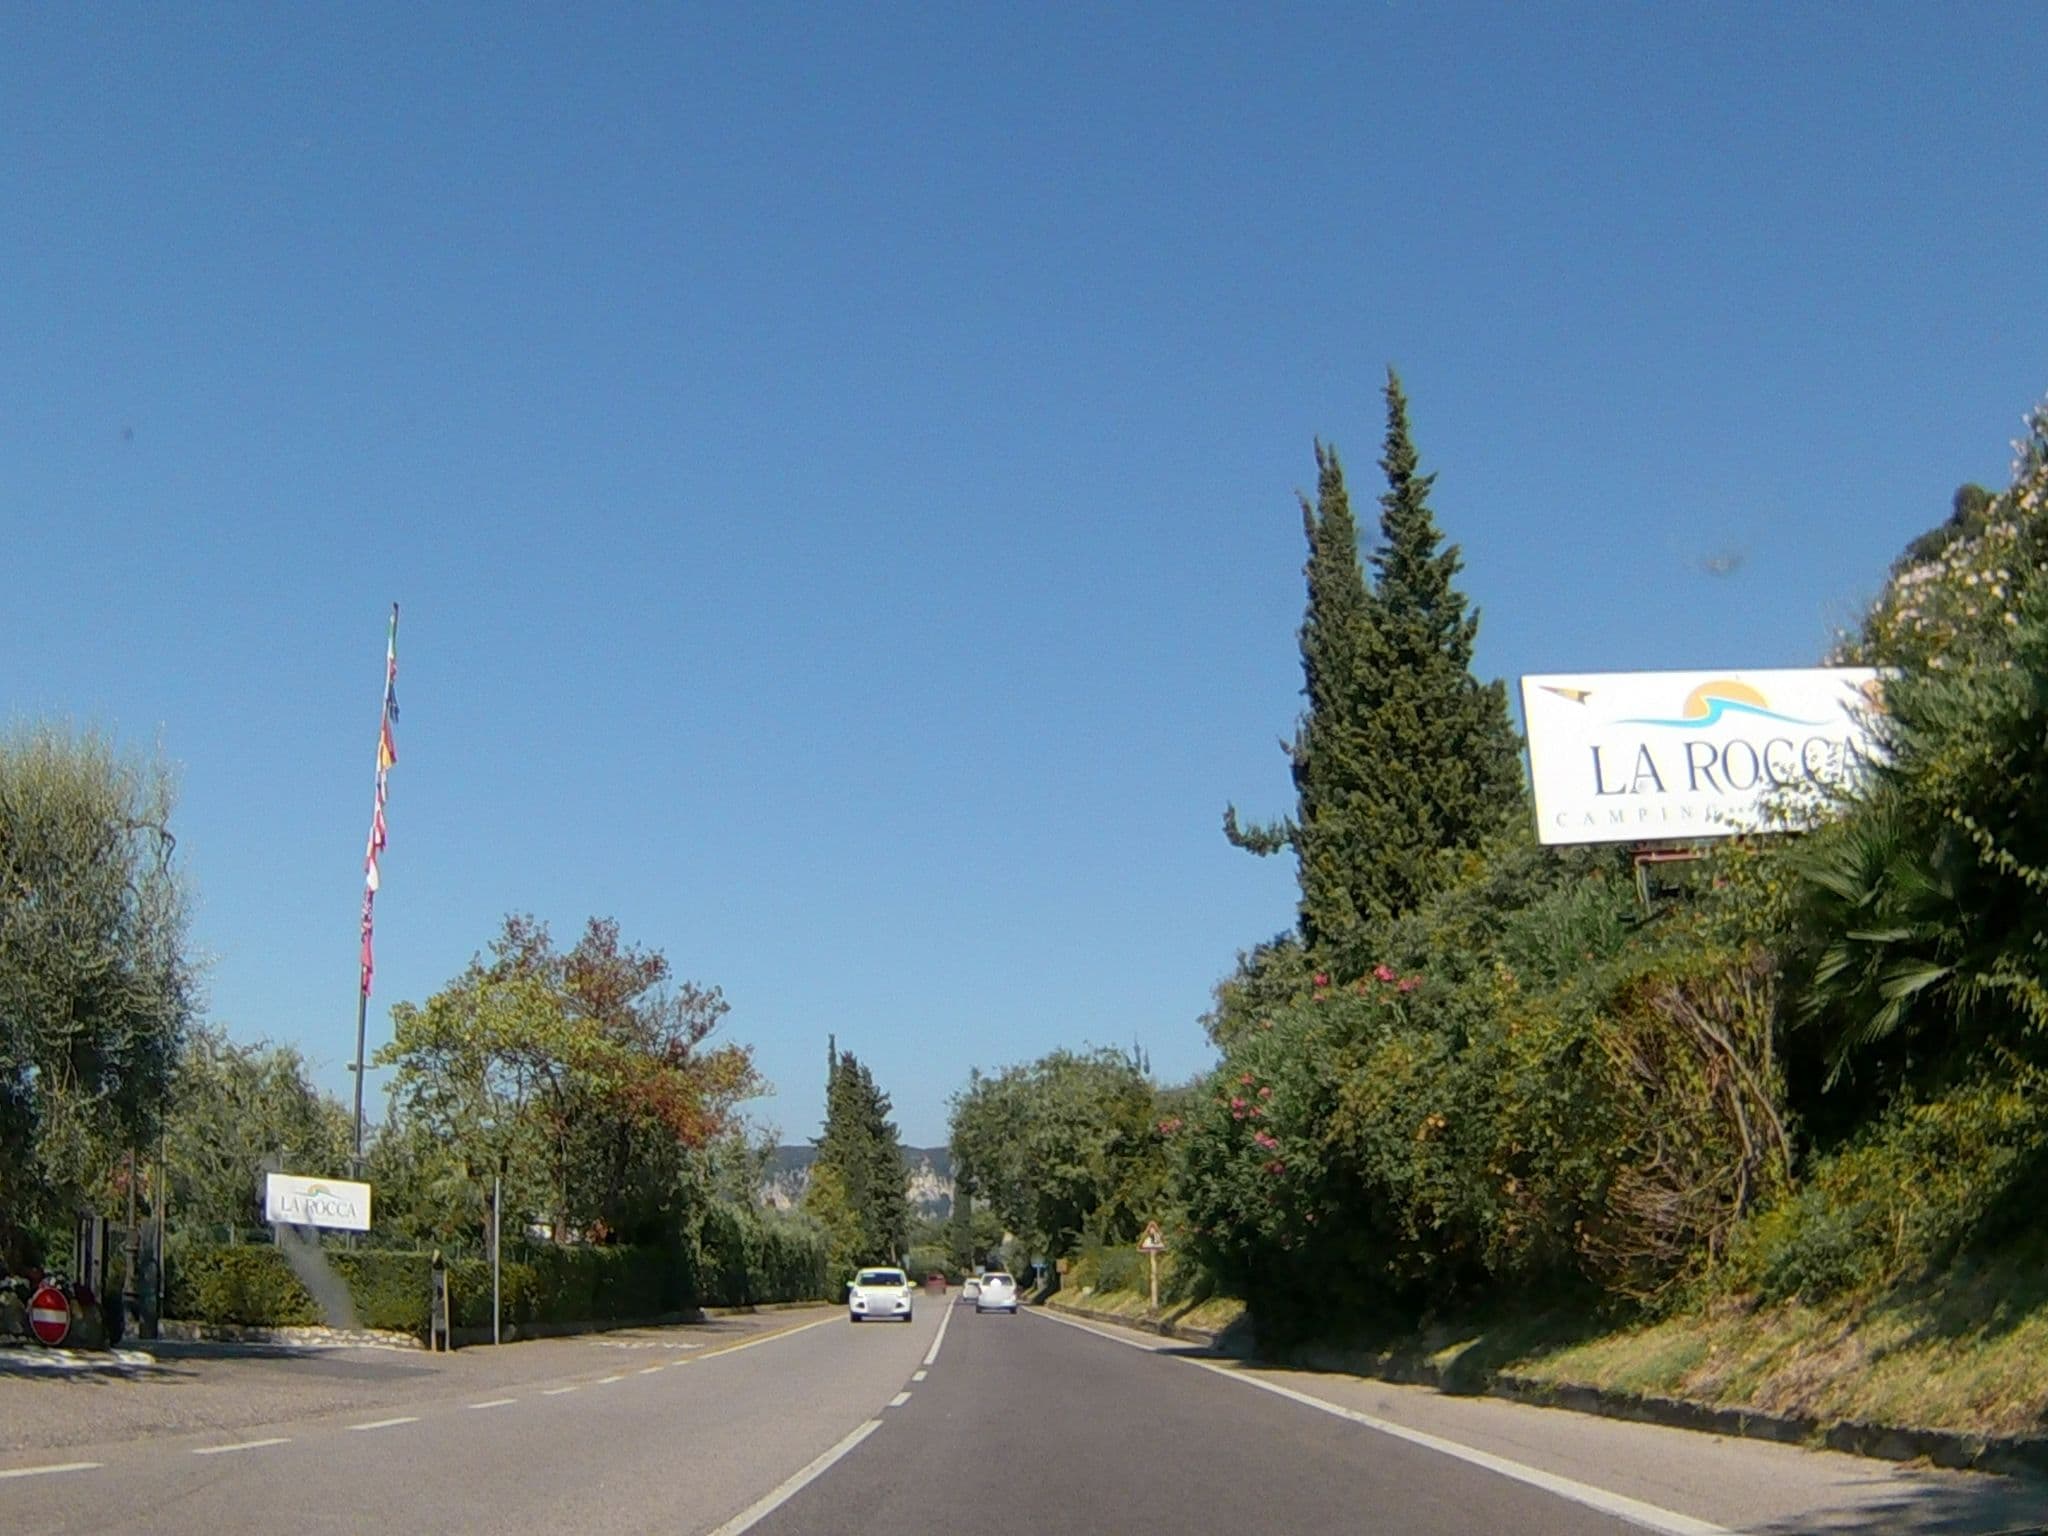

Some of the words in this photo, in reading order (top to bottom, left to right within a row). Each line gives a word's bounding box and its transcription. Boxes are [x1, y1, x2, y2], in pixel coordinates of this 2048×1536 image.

[1589, 742, 1666, 796] LA
[1683, 736, 1867, 796] ROCCA
[281, 1195, 300, 1213] LA
[306, 1198, 357, 1218] ROCCA
